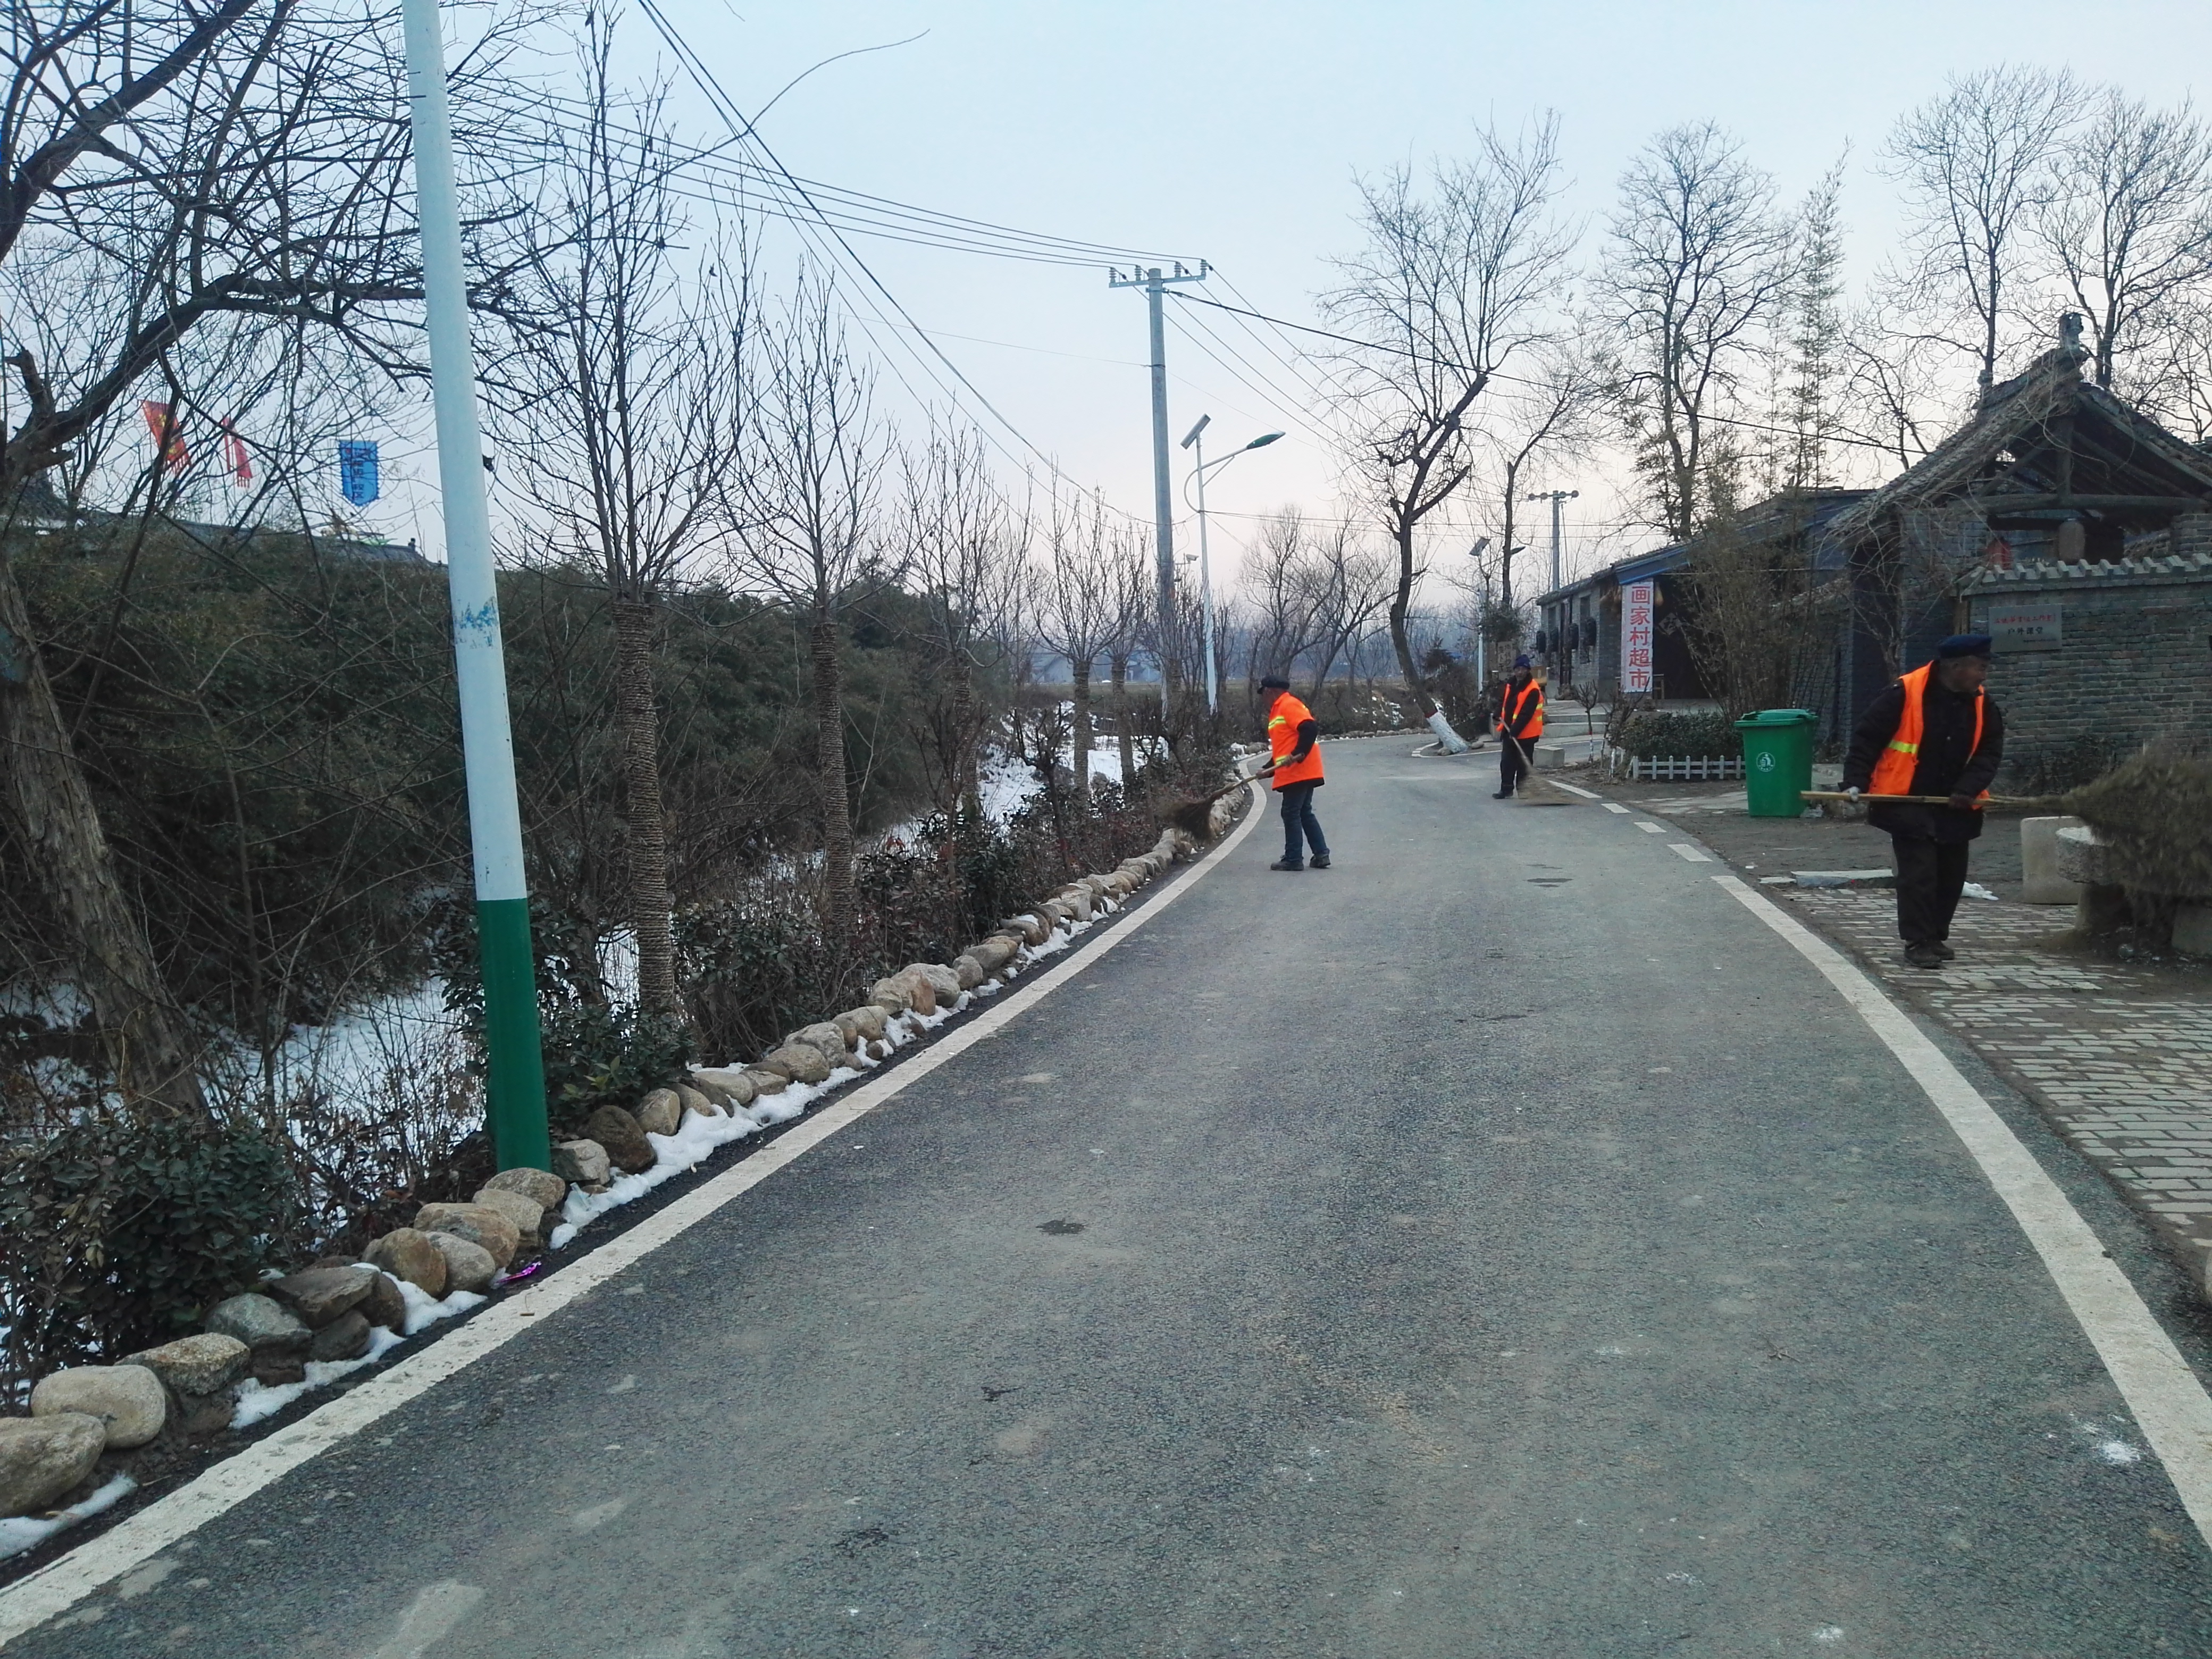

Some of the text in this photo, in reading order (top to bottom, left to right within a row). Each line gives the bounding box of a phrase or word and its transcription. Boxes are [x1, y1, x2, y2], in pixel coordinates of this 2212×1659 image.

[1629, 586, 1651, 689] 画家村超市
